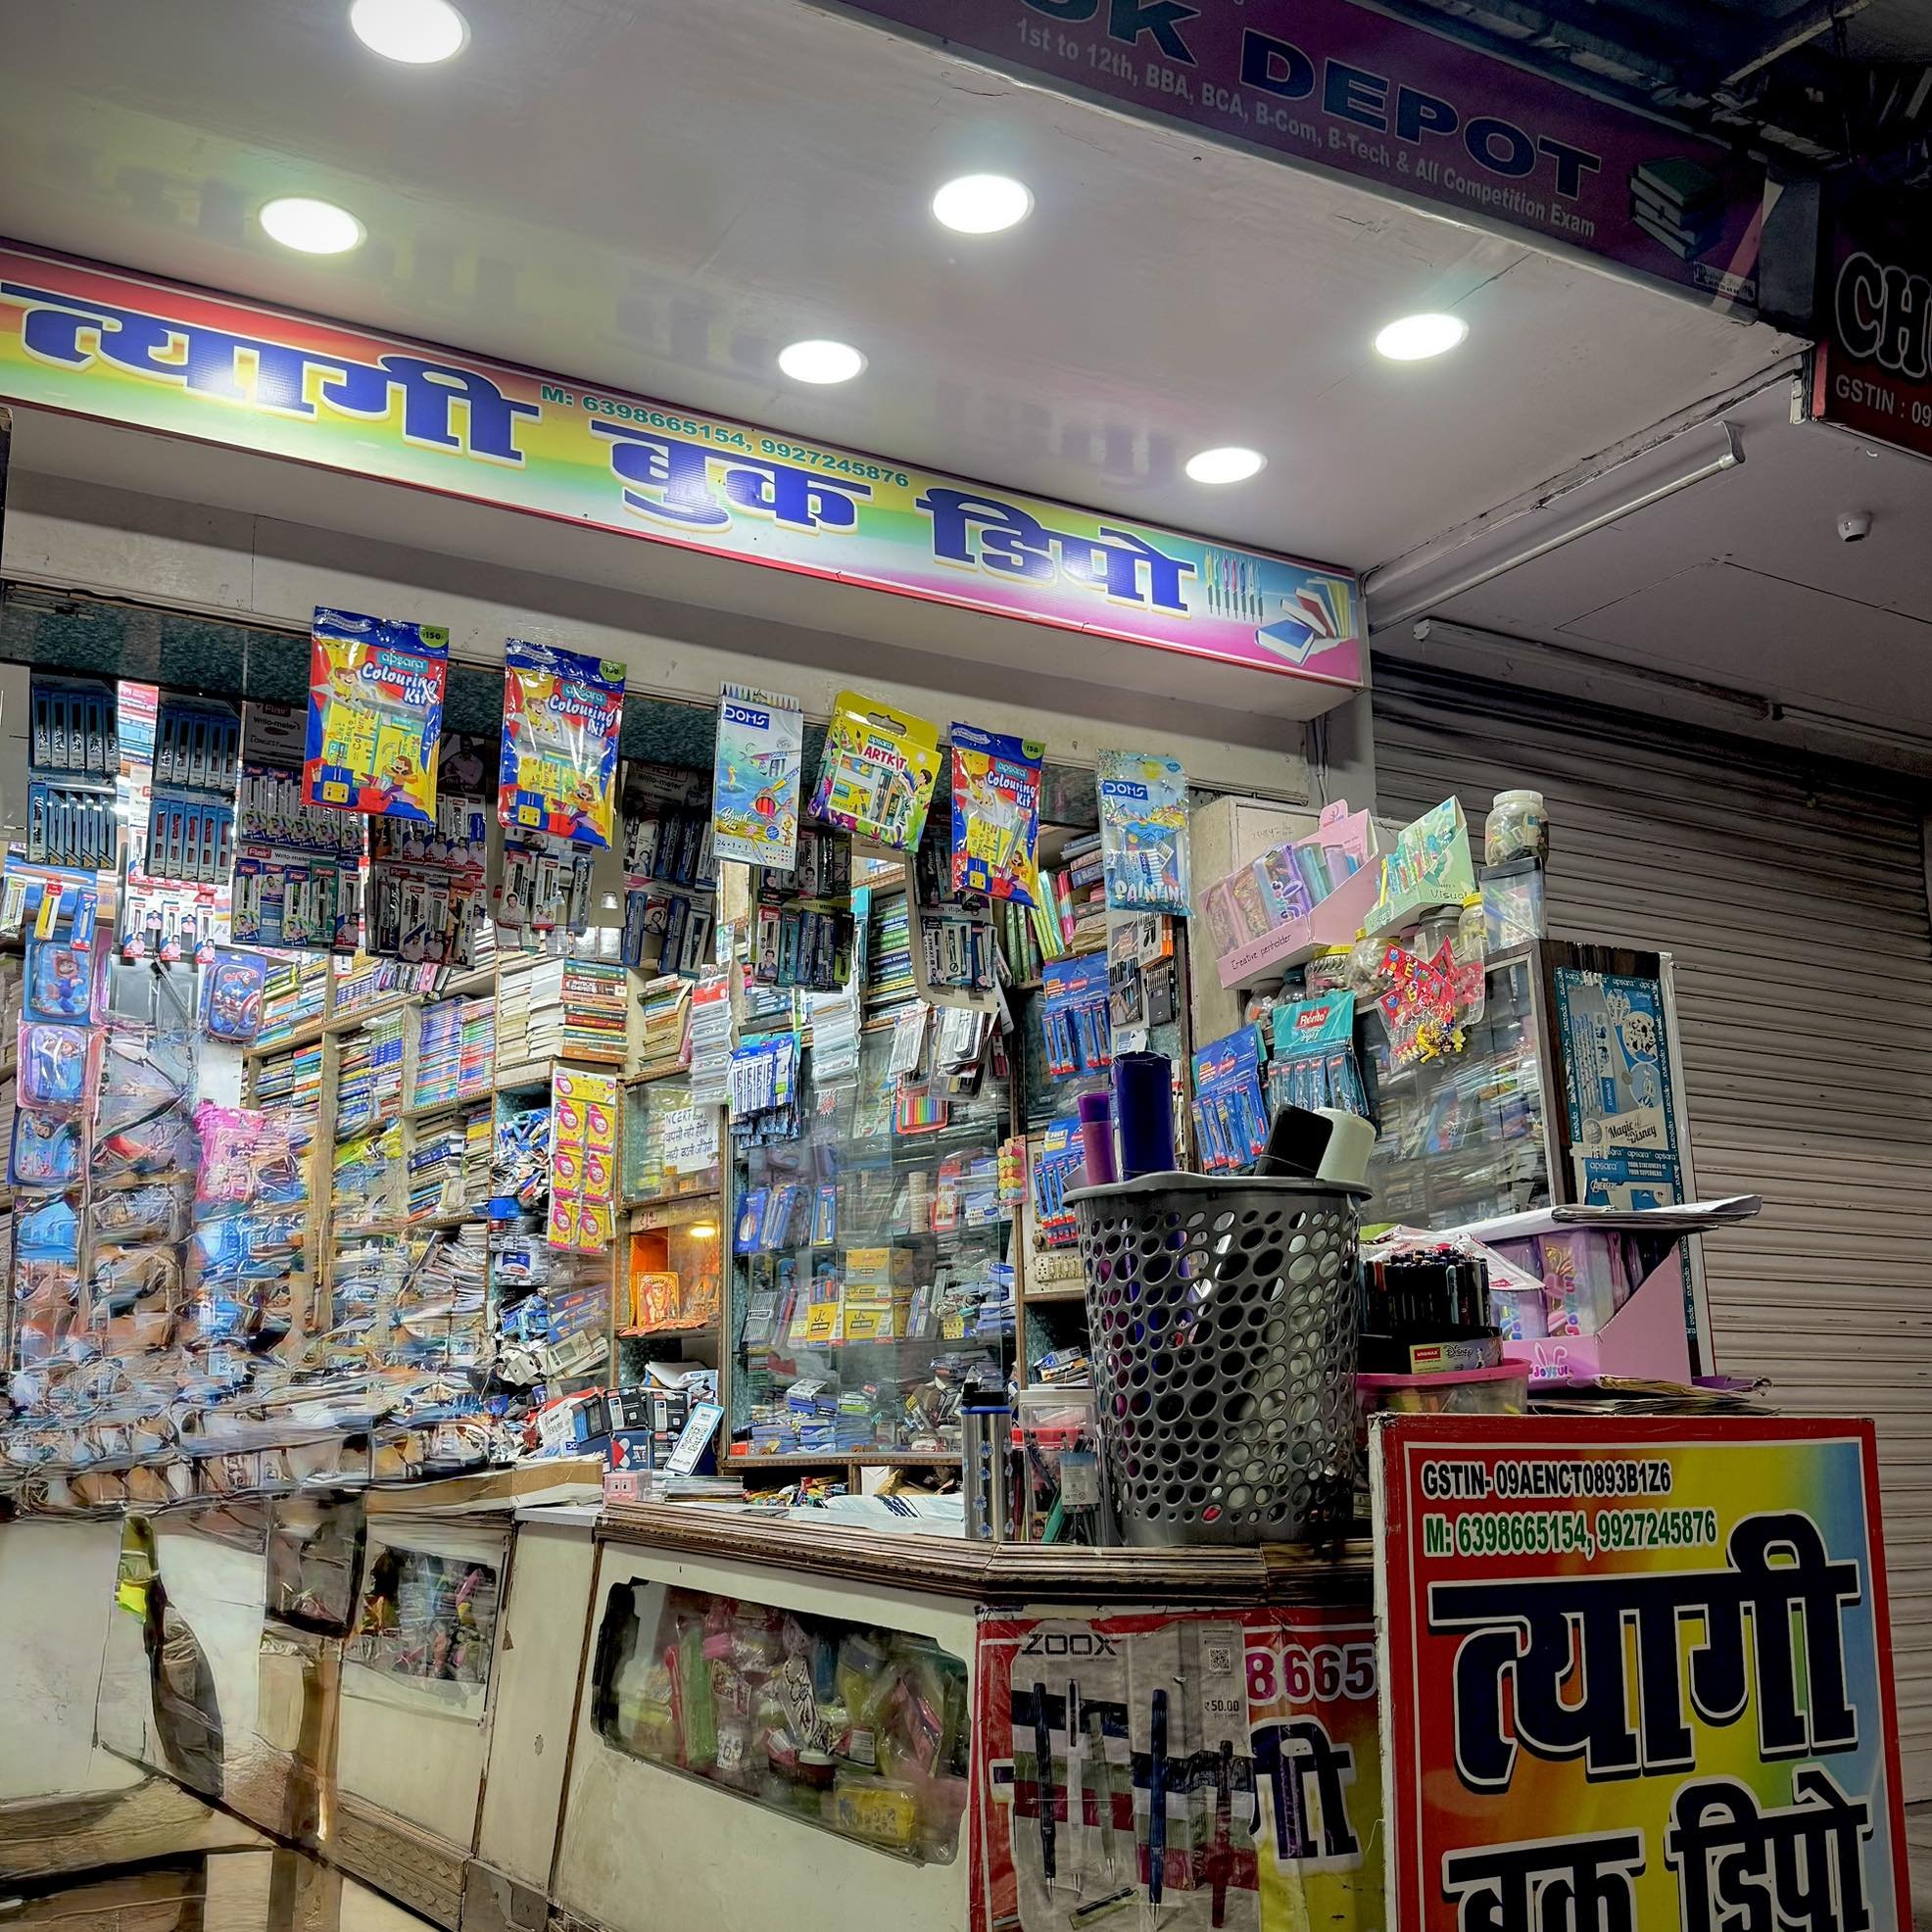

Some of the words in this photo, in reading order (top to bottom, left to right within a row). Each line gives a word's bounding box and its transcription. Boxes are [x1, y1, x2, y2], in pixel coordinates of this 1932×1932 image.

[1016, 18, 1052, 53] 1st
[1057, 34, 1079, 60] to
[1087, 43, 1138, 86] 12th,
[1145, 63, 1194, 105] BBA,
[1201, 83, 1249, 123] BCA,
[1255, 101, 1324, 147] B-Com,
[1328, 127, 1391, 168] B-Tech
[1395, 150, 1411, 174] &
[1415, 157, 1439, 184] All
[1443, 167, 1547, 222] Competition
[1550, 203, 1596, 239] Exam
[1238, 26, 1602, 202] DEPOT
[1835, 252, 1932, 379] CH
[0, 279, 542, 465] त्यागी
[1835, 374, 1896, 416] GSTIN
[541, 385, 575, 408] M:
[582, 396, 753, 454] 6398665154,
[760, 438, 910, 488] 9927245876
[590, 418, 872, 533] बुक
[915, 486, 1199, 618] डिपो
[381, 652, 425, 668] apsara
[361, 661, 438, 694] Colouring
[549, 693, 615, 728] Colouring
[724, 705, 769, 727] DOMS
[987, 769, 1037, 798] Colouring
[1104, 782, 1146, 797] DOMS
[1016, 792, 1033, 808] Kit
[1115, 880, 1183, 904] PAINTIN
[1231, 952, 1259, 970] Creative
[1628, 1124, 1658, 1144] Disney
[1589, 1162, 1618, 1173] apsara
[1626, 1149, 1650, 1159] apsara
[1654, 1152, 1677, 1162] apsara
[1424, 1515, 1454, 1556] M:
[1457, 1512, 1594, 1561] 6398665154,
[1598, 1508, 1717, 1550] 9927245876
[1021, 1633, 1118, 1656] ZOOX
[1427, 1510, 1860, 1793] त्यागी
